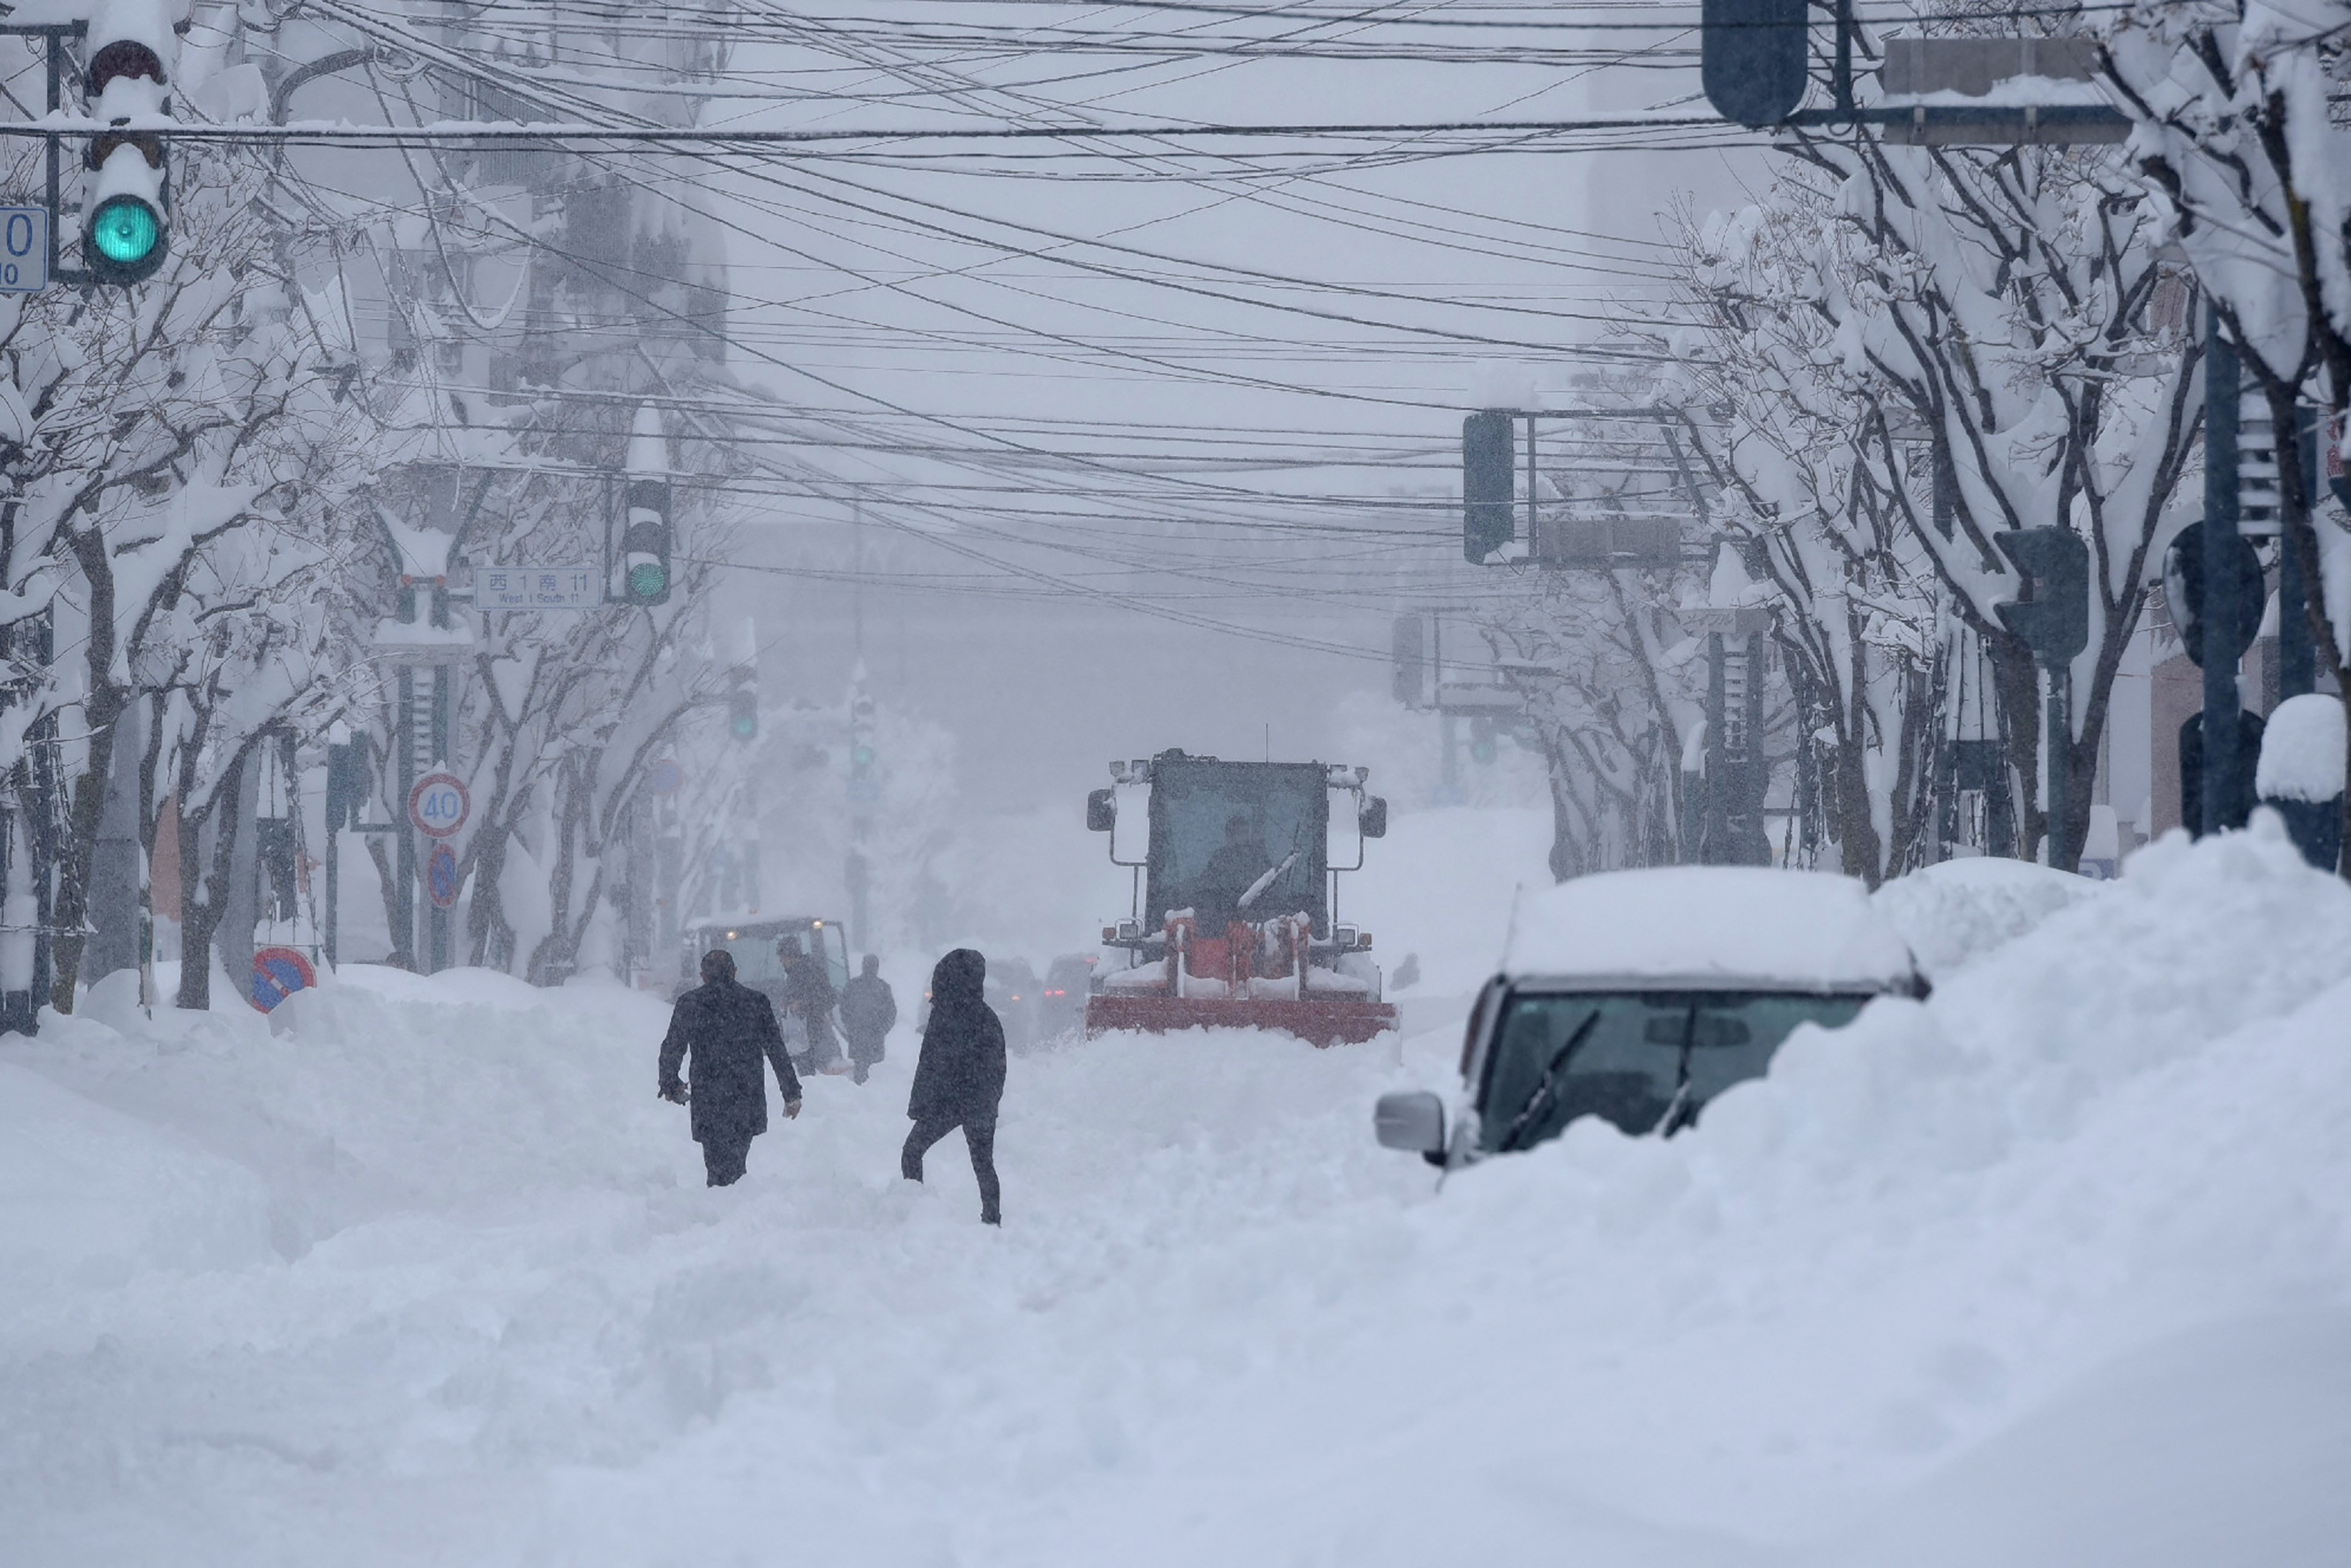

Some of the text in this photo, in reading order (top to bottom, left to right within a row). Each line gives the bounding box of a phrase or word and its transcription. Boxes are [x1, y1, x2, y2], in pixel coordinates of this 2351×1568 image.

[489, 573, 587, 591] 西 1 南 11
[499, 593, 524, 603] West
[536, 592, 565, 603] South
[423, 791, 458, 819] 40
